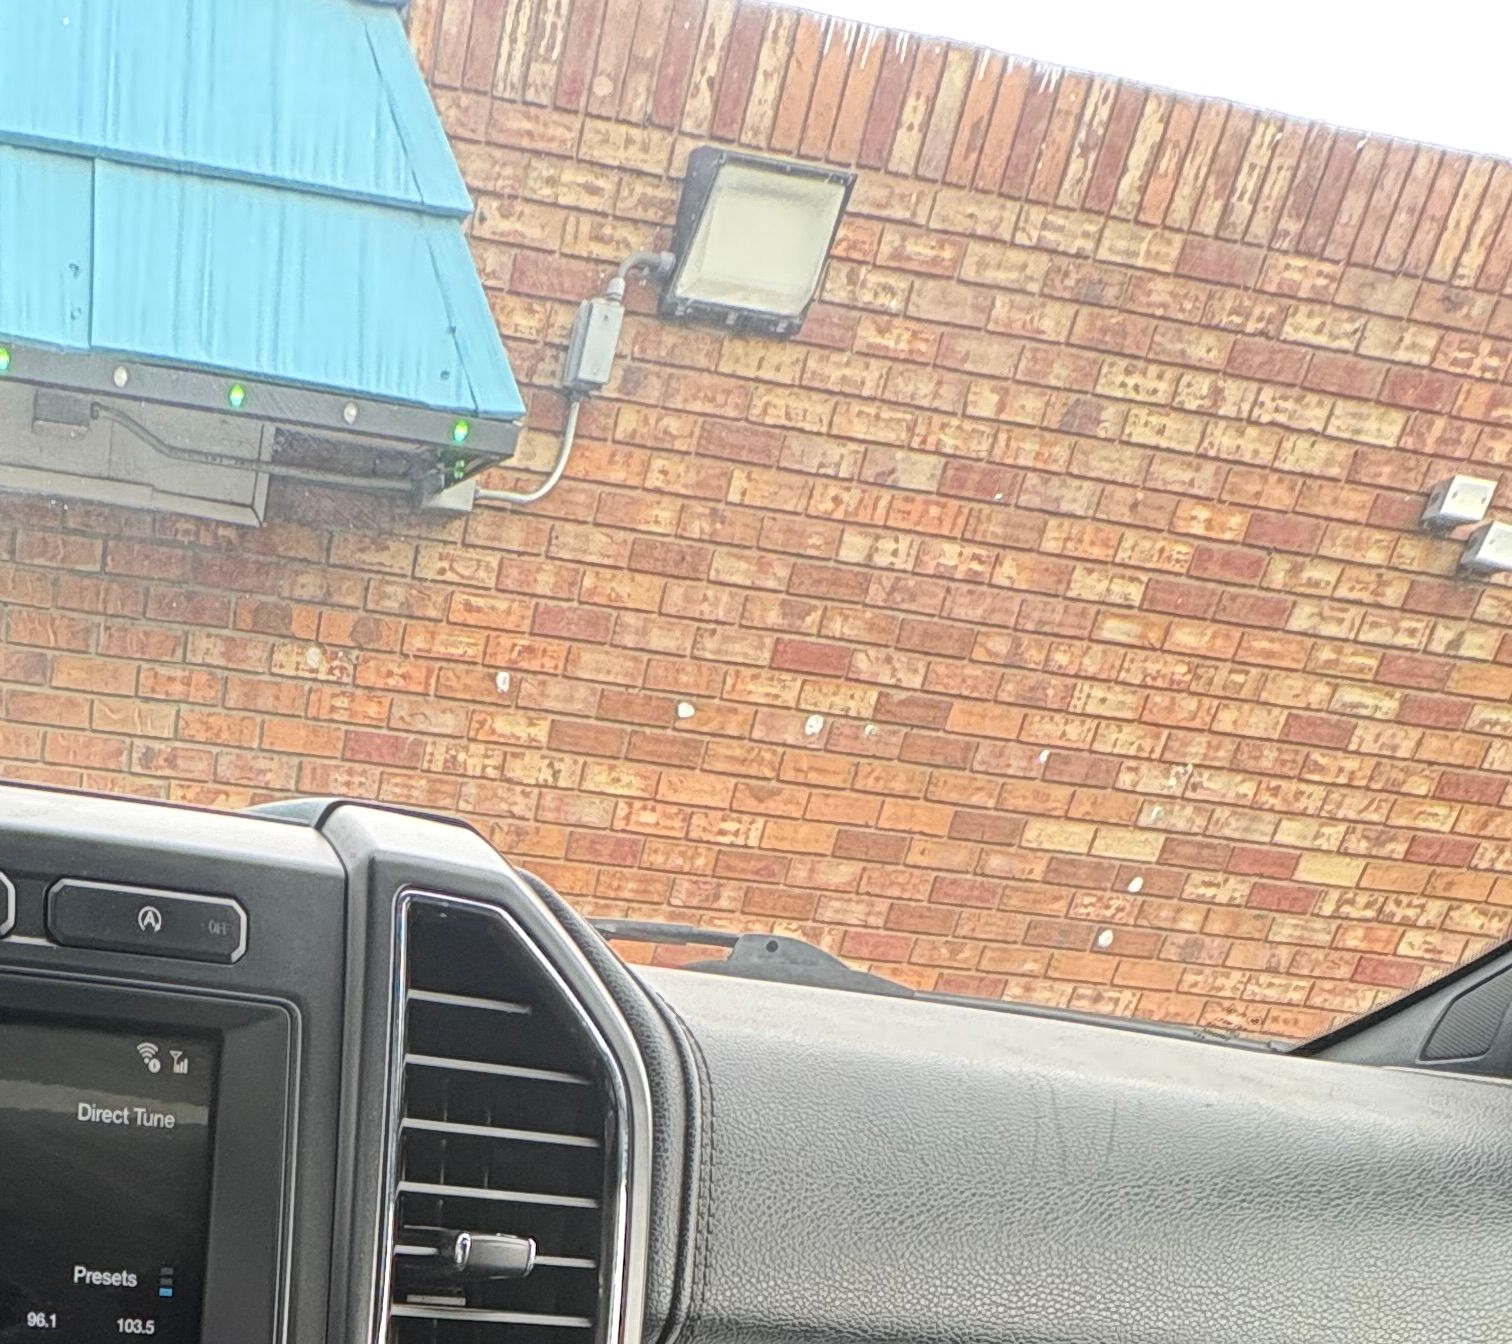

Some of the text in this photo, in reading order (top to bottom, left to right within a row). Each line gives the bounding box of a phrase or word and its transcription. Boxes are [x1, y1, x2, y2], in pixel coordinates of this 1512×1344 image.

[77, 1102, 176, 1129] Direct Tune
[73, 1265, 138, 1288] Presets
[27, 1312, 57, 1328] 96.1
[117, 1318, 155, 1335] 103.5
